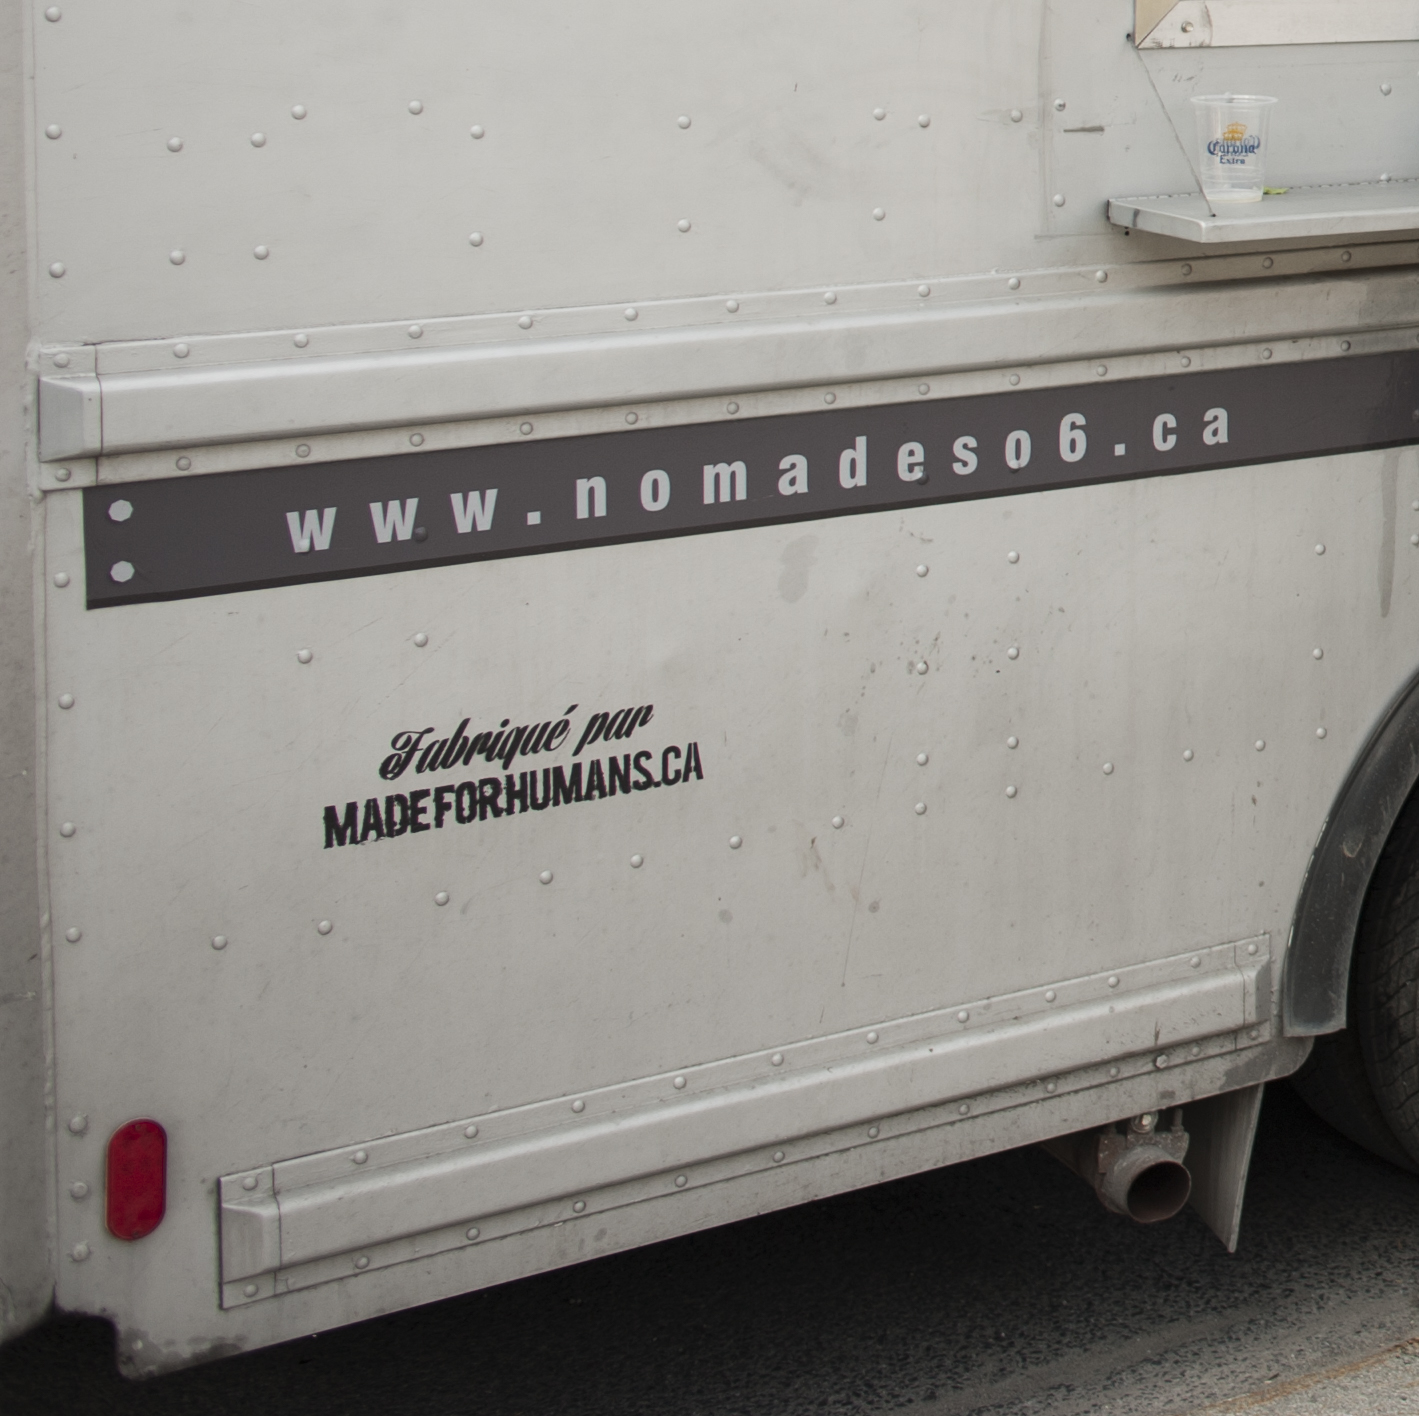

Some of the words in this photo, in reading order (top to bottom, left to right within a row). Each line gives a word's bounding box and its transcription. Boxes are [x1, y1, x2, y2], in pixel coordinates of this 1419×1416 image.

[1206, 137, 1259, 157] Corona
[284, 397, 1233, 556] www.nomadeso6.ca
[378, 703, 580, 781] Fabriqué
[572, 703, 655, 757] par
[323, 740, 705, 850] MADEFORHUMANS.CA
